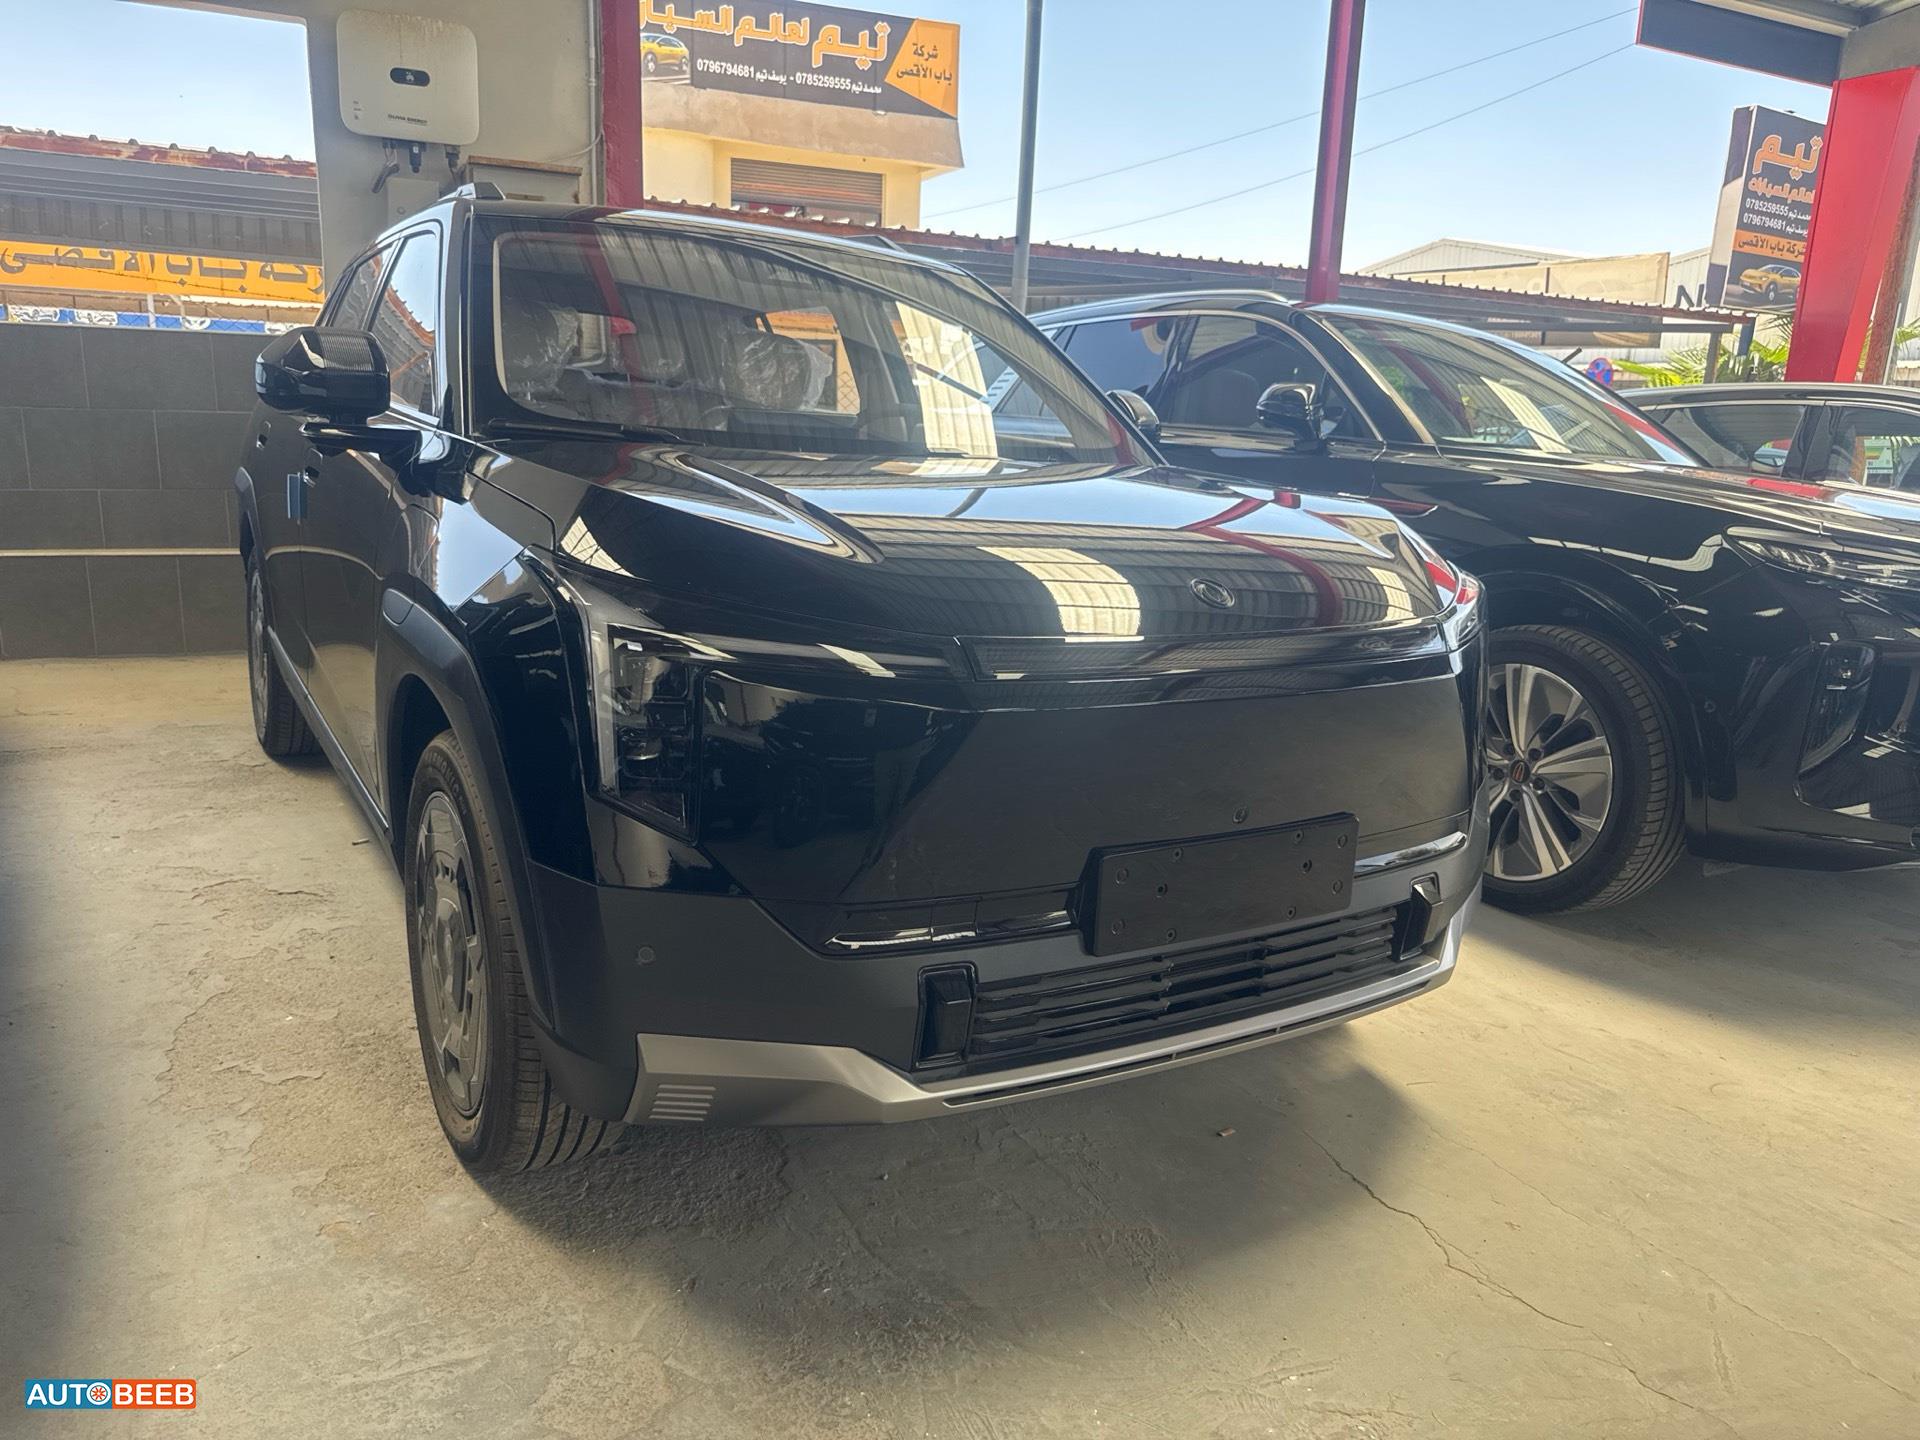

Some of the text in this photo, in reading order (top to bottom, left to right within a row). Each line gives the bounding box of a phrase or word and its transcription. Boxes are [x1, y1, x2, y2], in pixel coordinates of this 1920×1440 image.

[734, 12, 811, 47] لعالم
[811, 21, 892, 70] تيم
[912, 42, 939, 61] شركة
[697, 58, 755, 79] 0796794681
[934, 68, 953, 86] باب
[795, 72, 852, 90] 0785259555
[1752, 134, 1823, 180] تيم
[1745, 198, 1789, 216] 0785259555
[1743, 212, 1786, 231] 0796794681
[1770, 241, 1785, 257] باب
